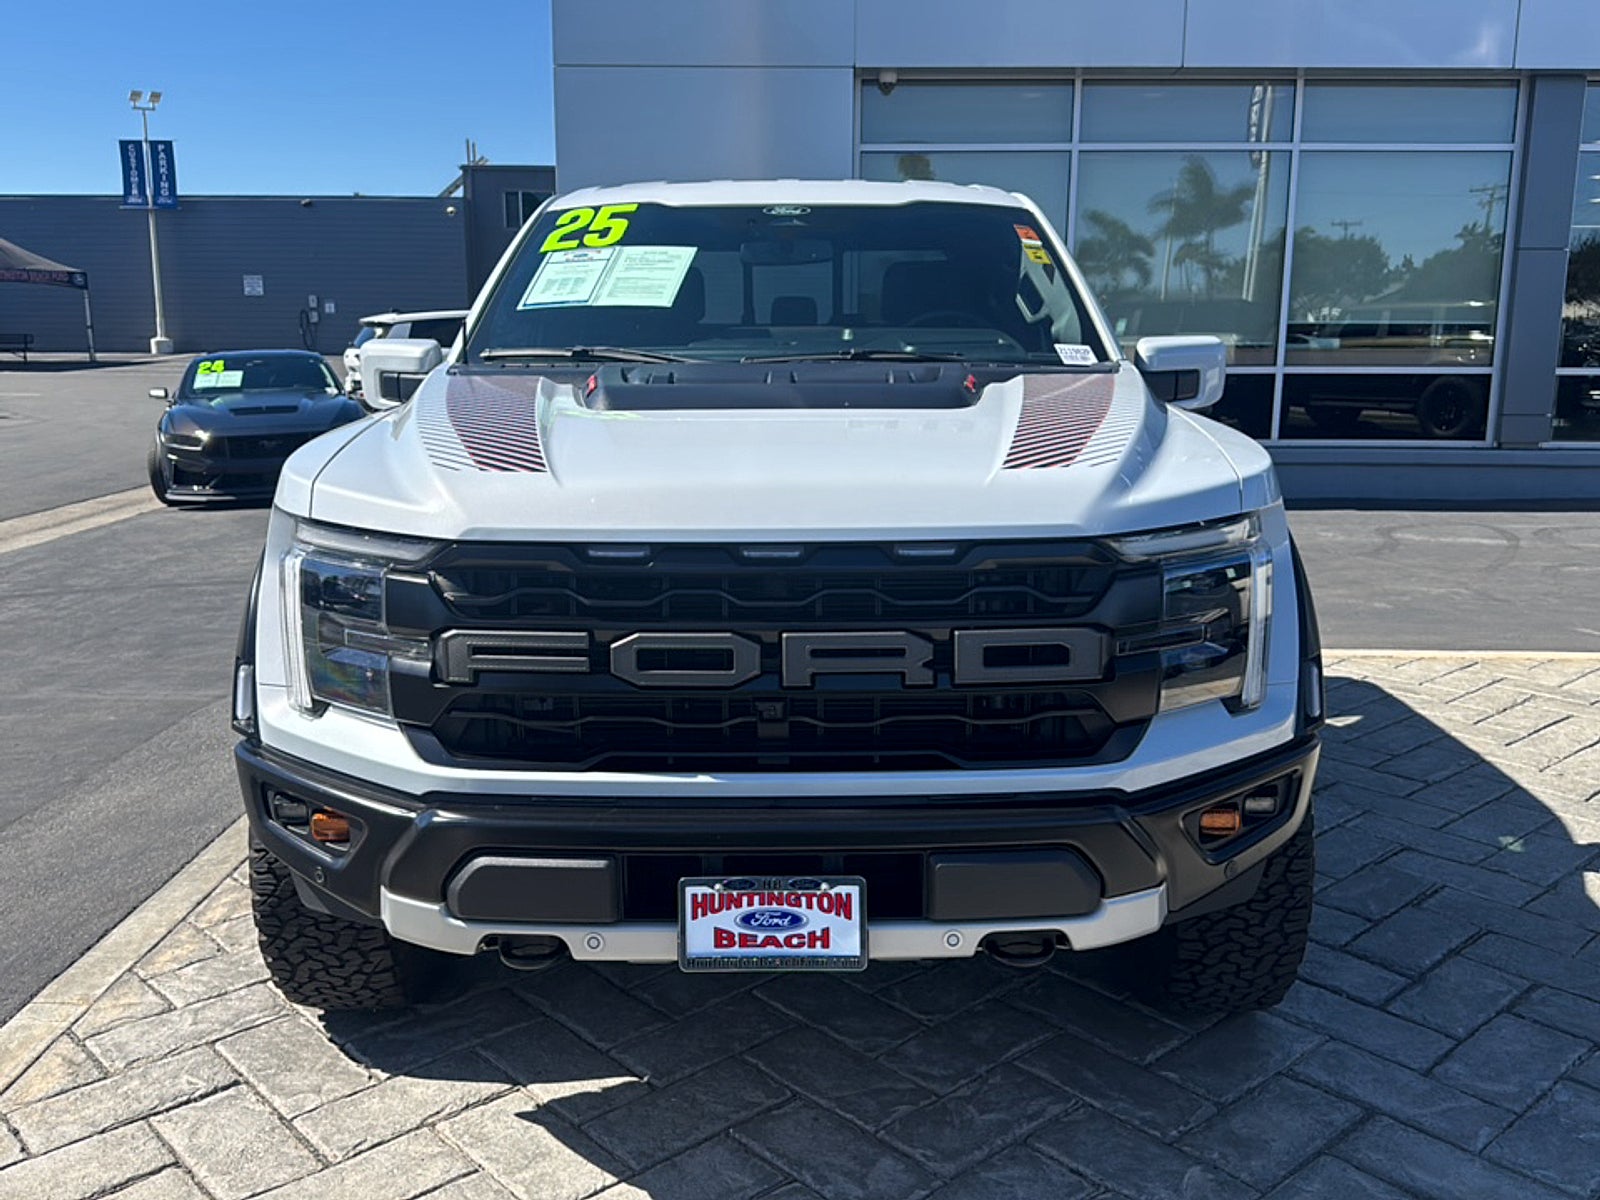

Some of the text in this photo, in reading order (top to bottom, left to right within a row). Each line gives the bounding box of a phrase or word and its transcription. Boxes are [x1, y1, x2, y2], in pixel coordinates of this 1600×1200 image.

[157, 144, 170, 196] PARKING
[539, 203, 640, 253] 25
[197, 360, 225, 375] 24
[436, 627, 1107, 689] FORD
[691, 890, 853, 921] HUNTINGTON
[749, 911, 793, 927] Ford
[713, 926, 831, 949] BEACH
